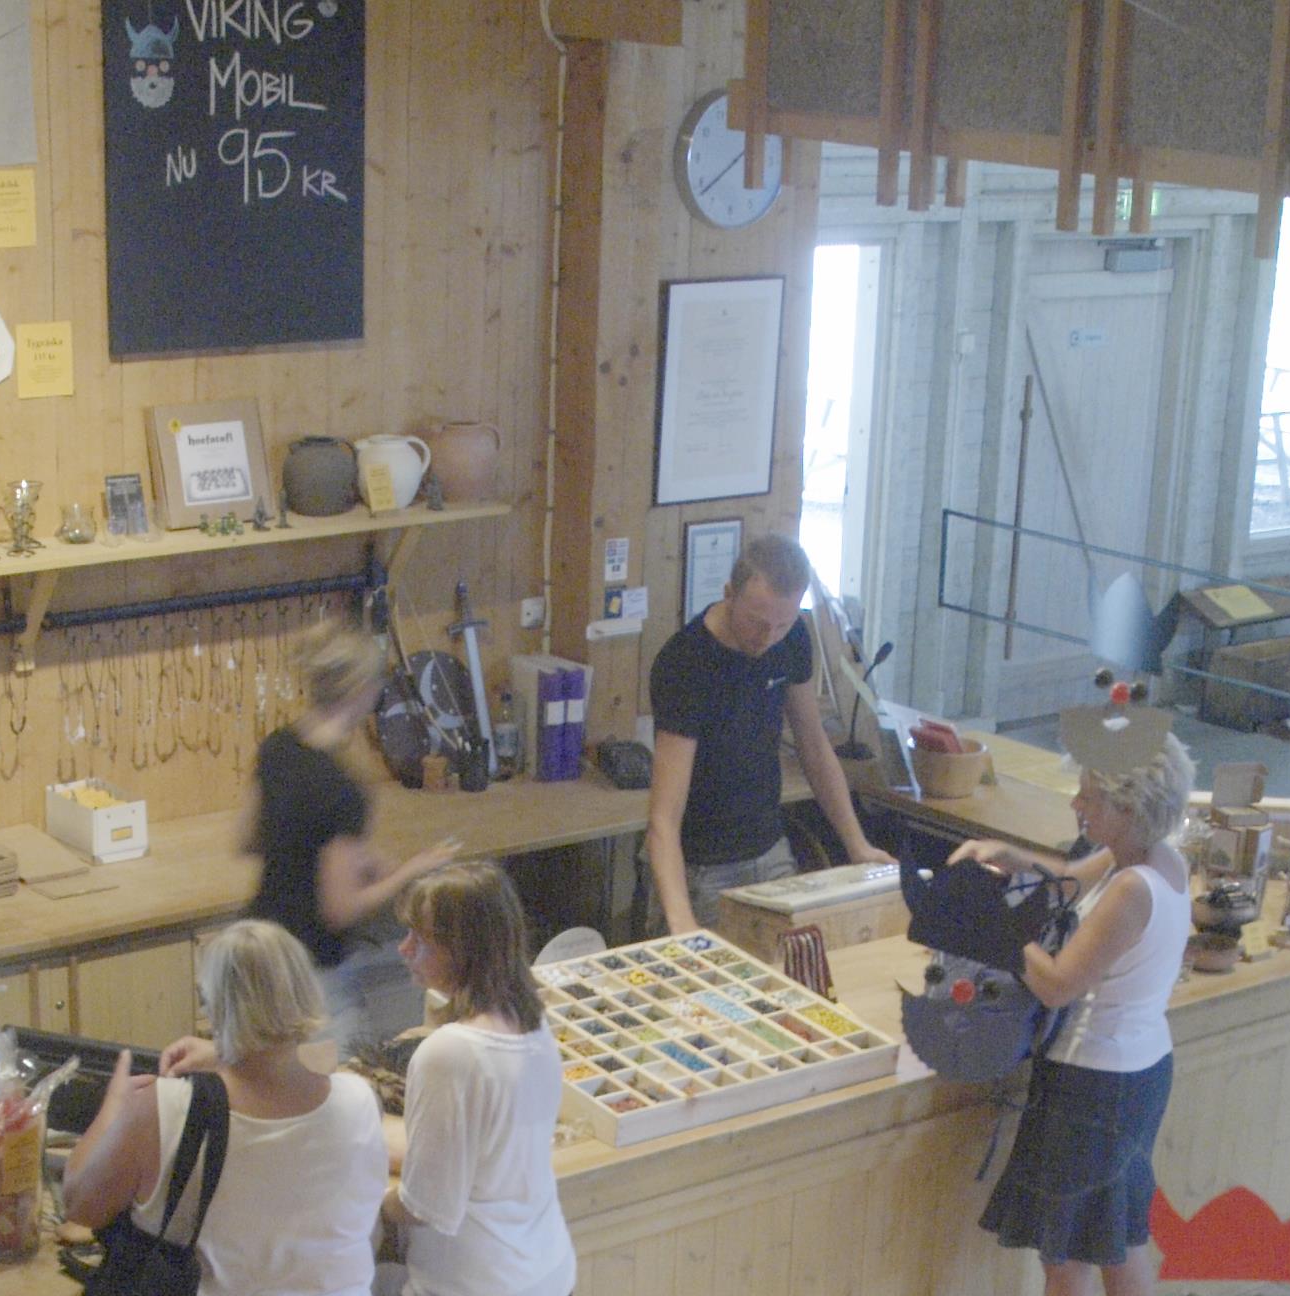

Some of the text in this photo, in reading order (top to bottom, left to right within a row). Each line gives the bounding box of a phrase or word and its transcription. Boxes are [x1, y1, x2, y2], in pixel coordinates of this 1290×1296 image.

[185, 0, 314, 45] VIKING
[209, 51, 328, 121] MOBIL
[166, 128, 349, 205] NU 95 KR
